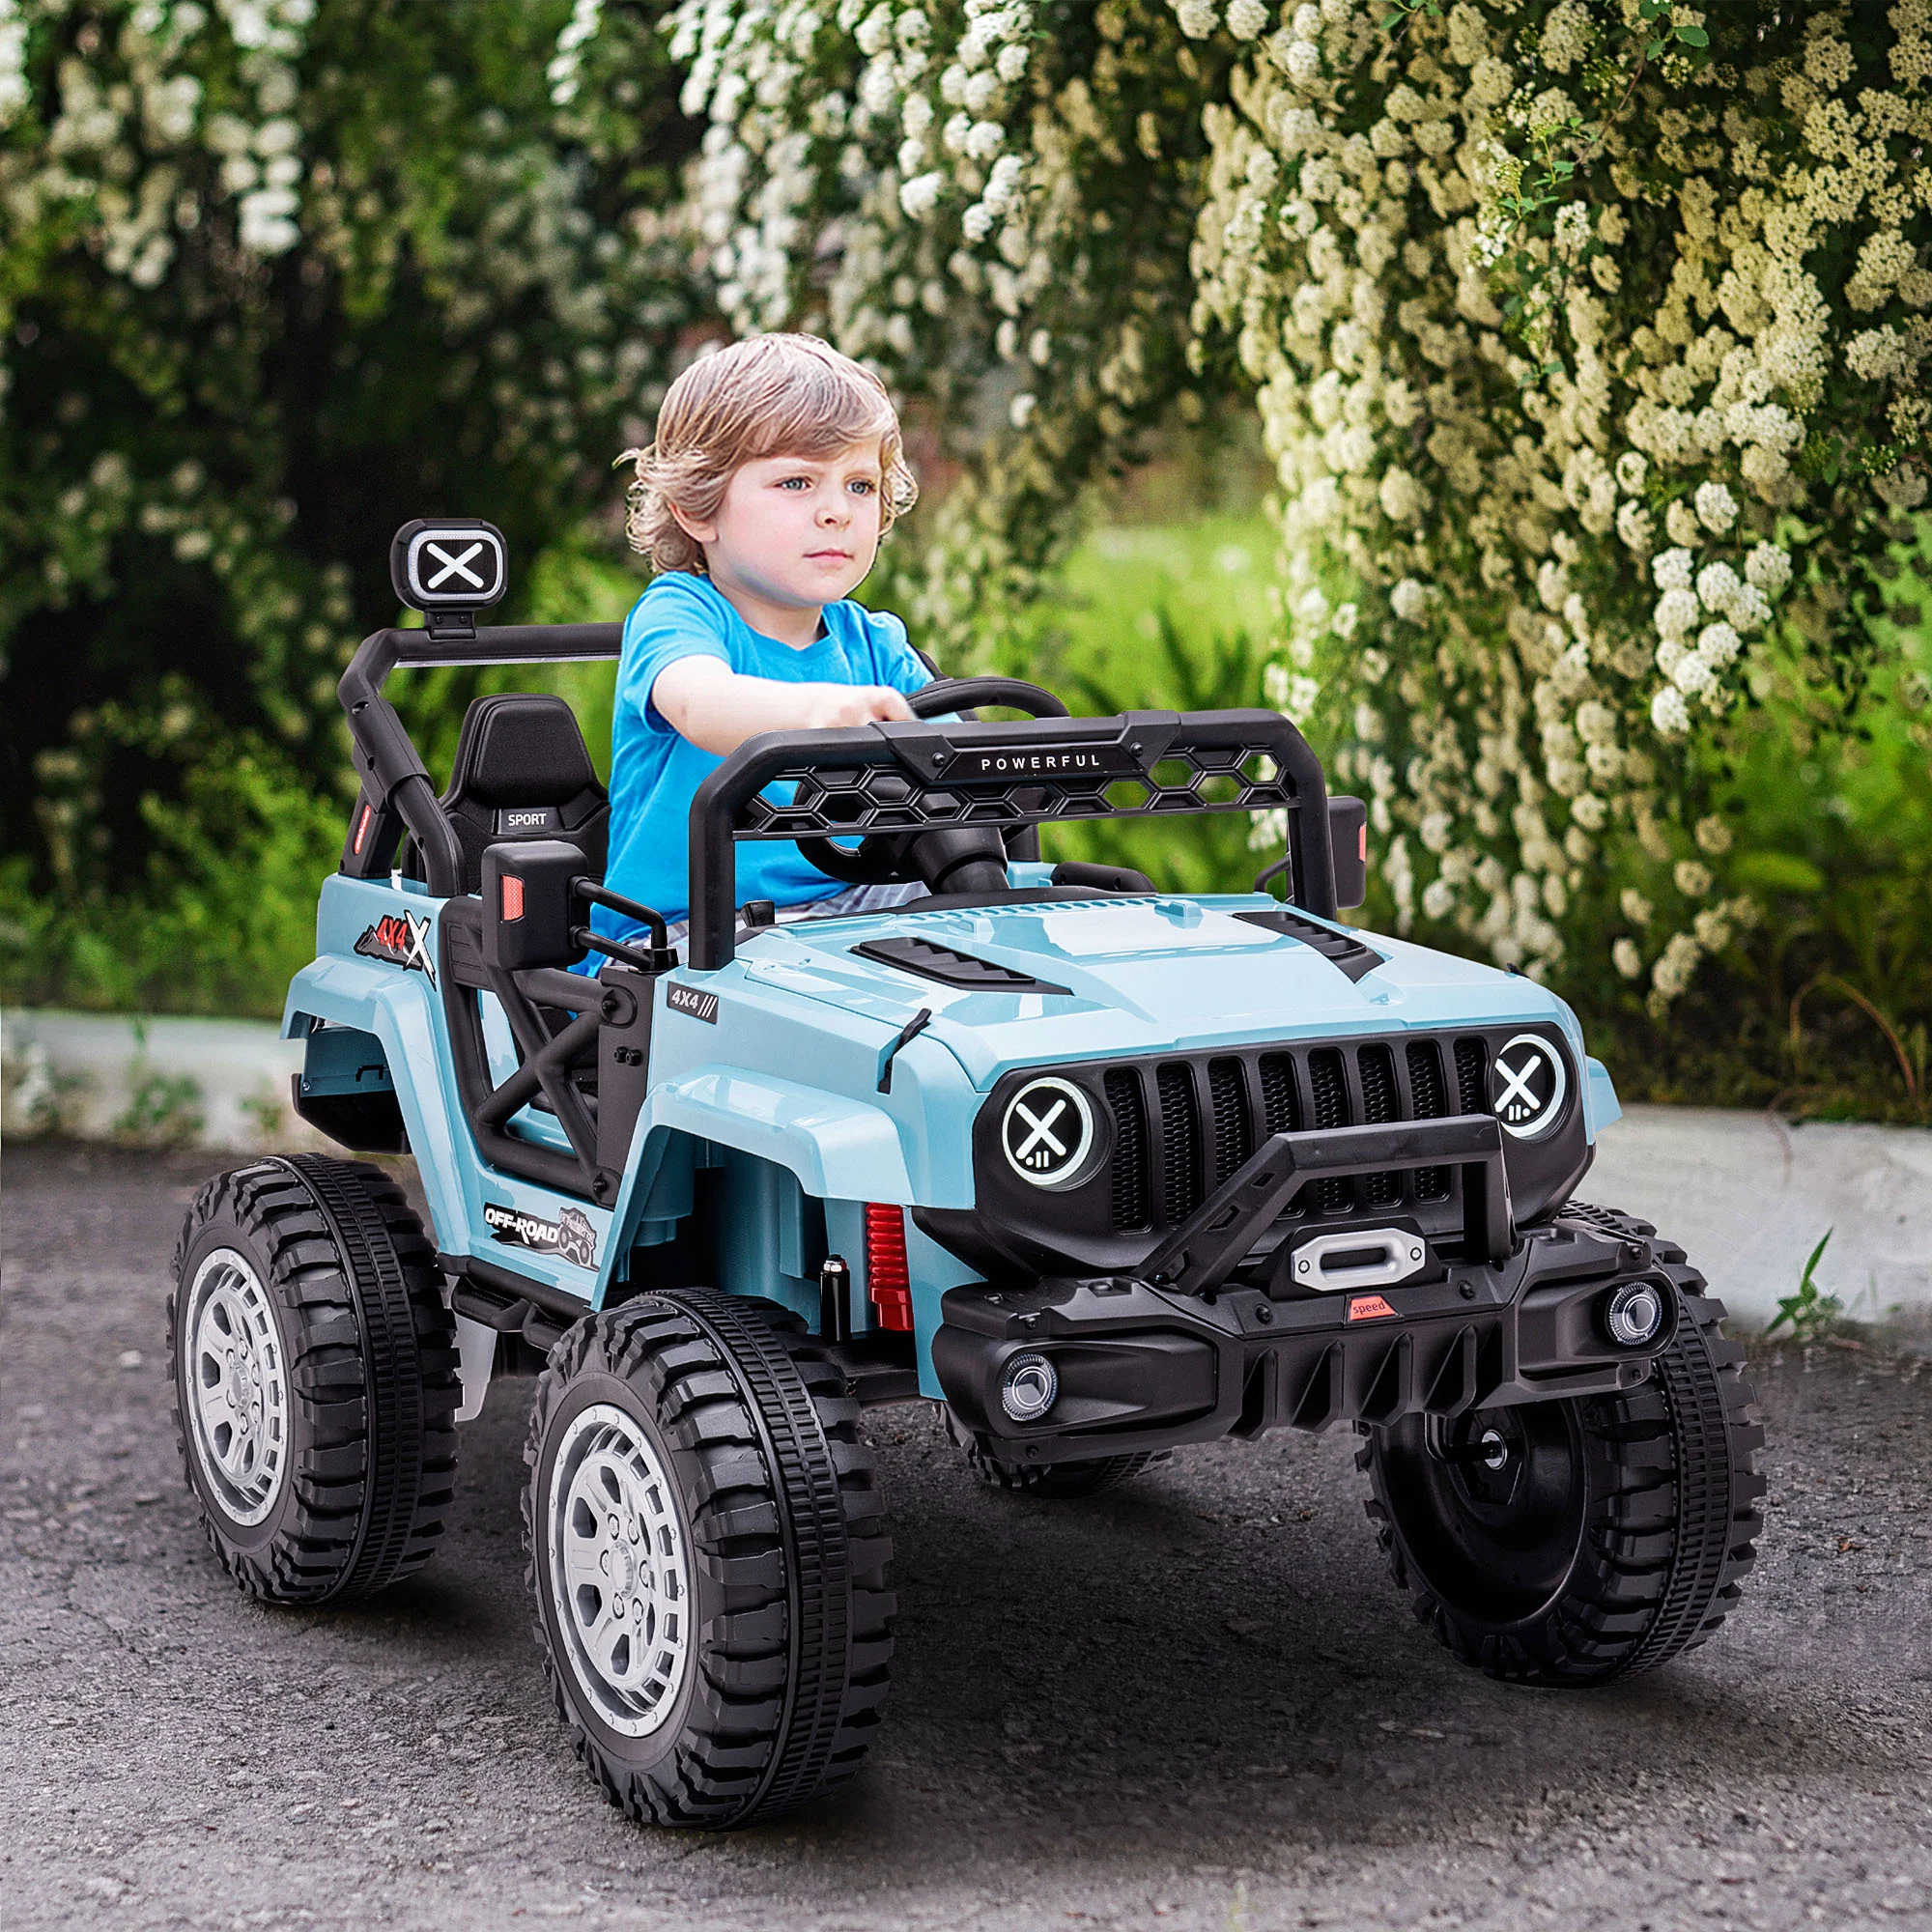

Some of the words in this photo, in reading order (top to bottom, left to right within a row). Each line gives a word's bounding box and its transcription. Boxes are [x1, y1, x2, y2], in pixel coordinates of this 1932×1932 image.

[980, 754, 1100, 771] POWERFUL
[508, 813, 547, 827] SPORT
[376, 918, 408, 951] 4X4
[671, 989, 699, 1009] 4X4
[485, 1208, 558, 1245] OFF-ROAD
[1352, 1300, 1385, 1315] speed
